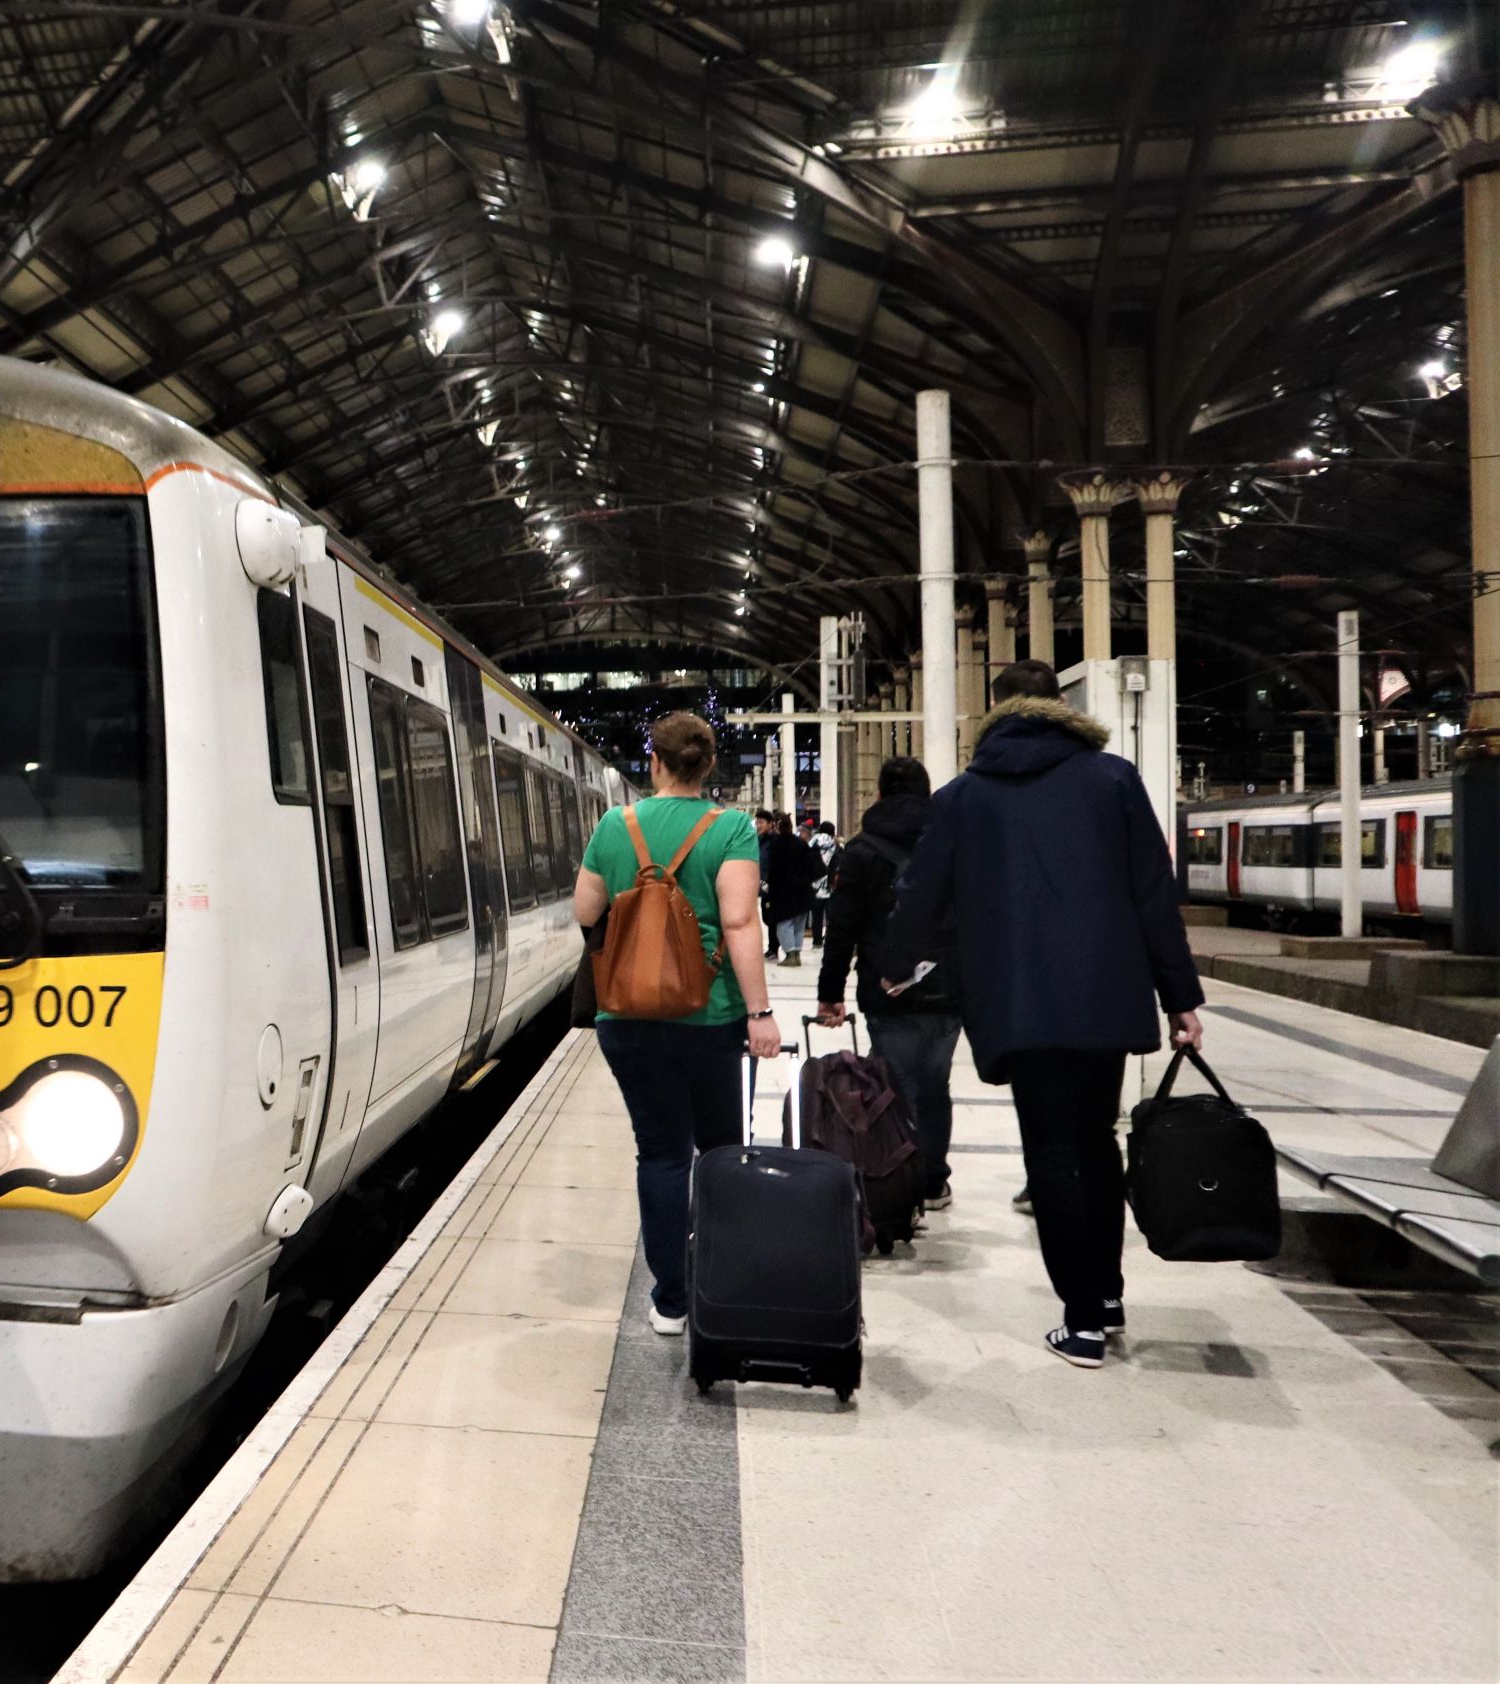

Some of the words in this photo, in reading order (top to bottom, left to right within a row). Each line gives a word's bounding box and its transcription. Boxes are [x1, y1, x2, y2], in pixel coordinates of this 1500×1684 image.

[712, 787, 720, 797] 6
[1247, 783, 1256, 794] 9
[35, 984, 127, 1028] 007
